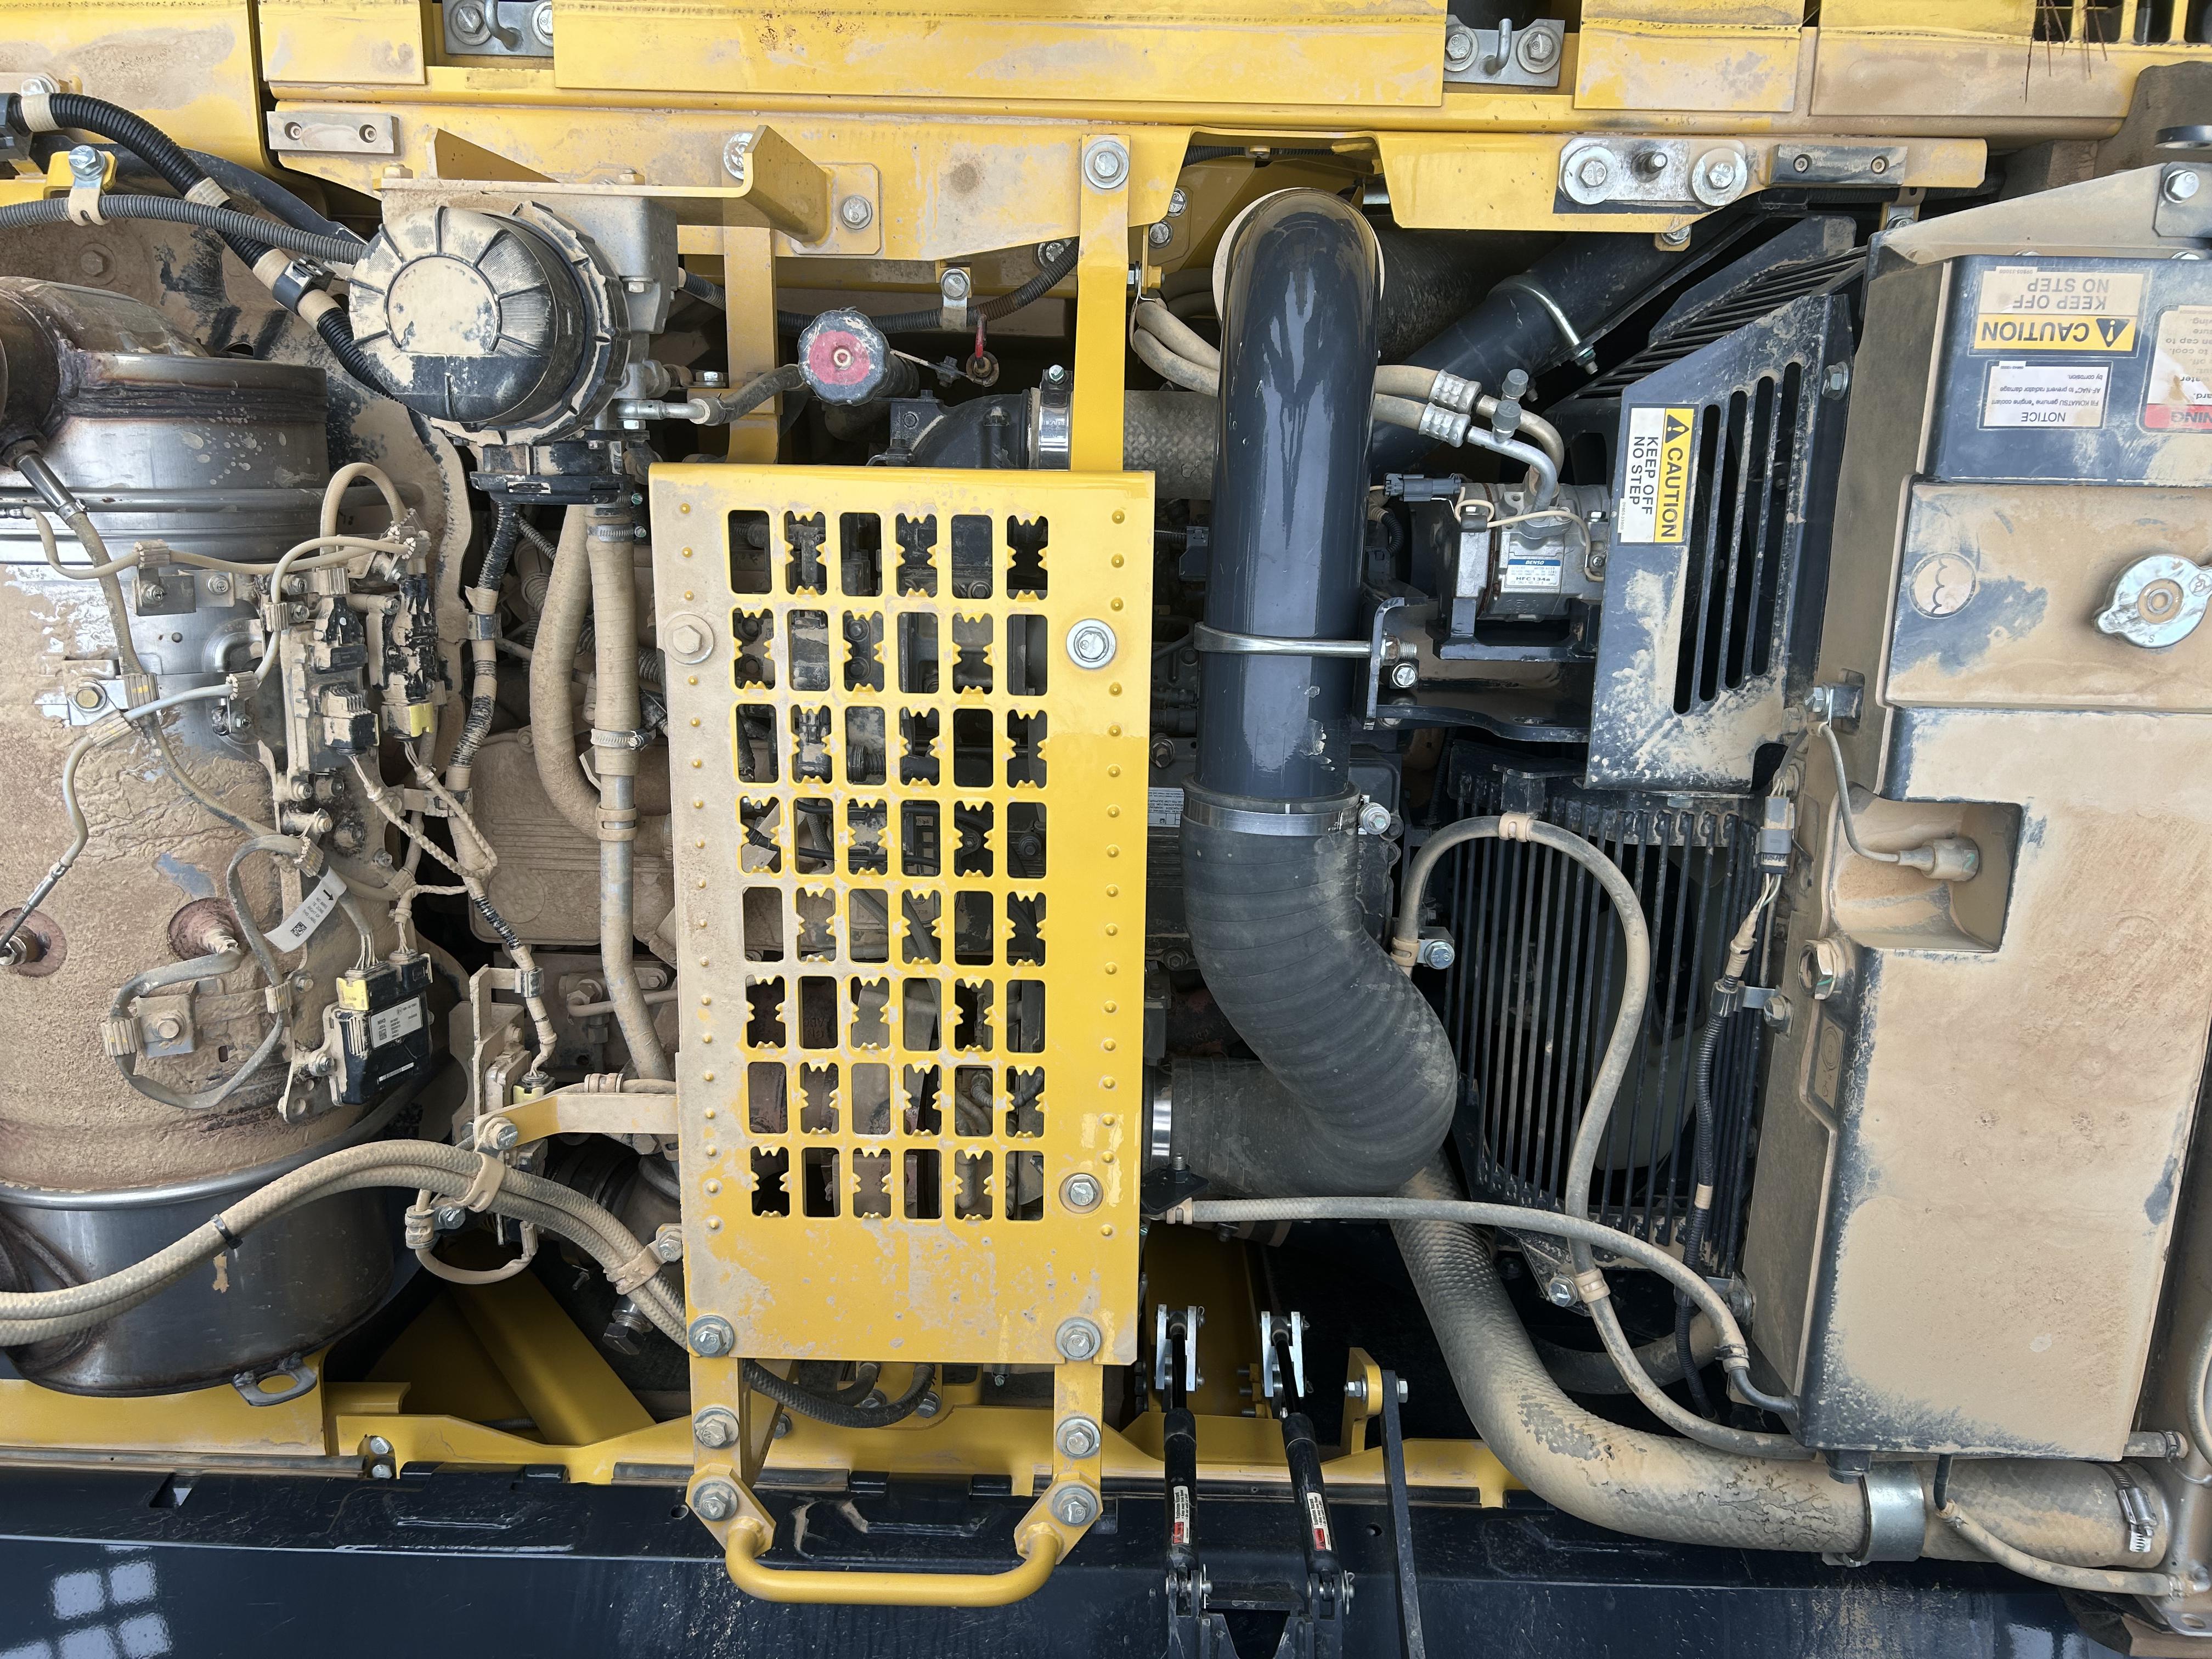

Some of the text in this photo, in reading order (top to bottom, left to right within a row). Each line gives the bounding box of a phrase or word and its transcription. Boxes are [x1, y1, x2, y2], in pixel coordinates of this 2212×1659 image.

[2027, 278, 2109, 293] NO STEP
[2012, 295, 2107, 310] KEEP OFF
[1982, 321, 2090, 341] CAUTION
[2021, 412, 2066, 422] NOTICE
[1629, 437, 1645, 505] NO STEP
[1641, 437, 1658, 515] KEEP OFF
[1661, 448, 1683, 537] CAUTION
